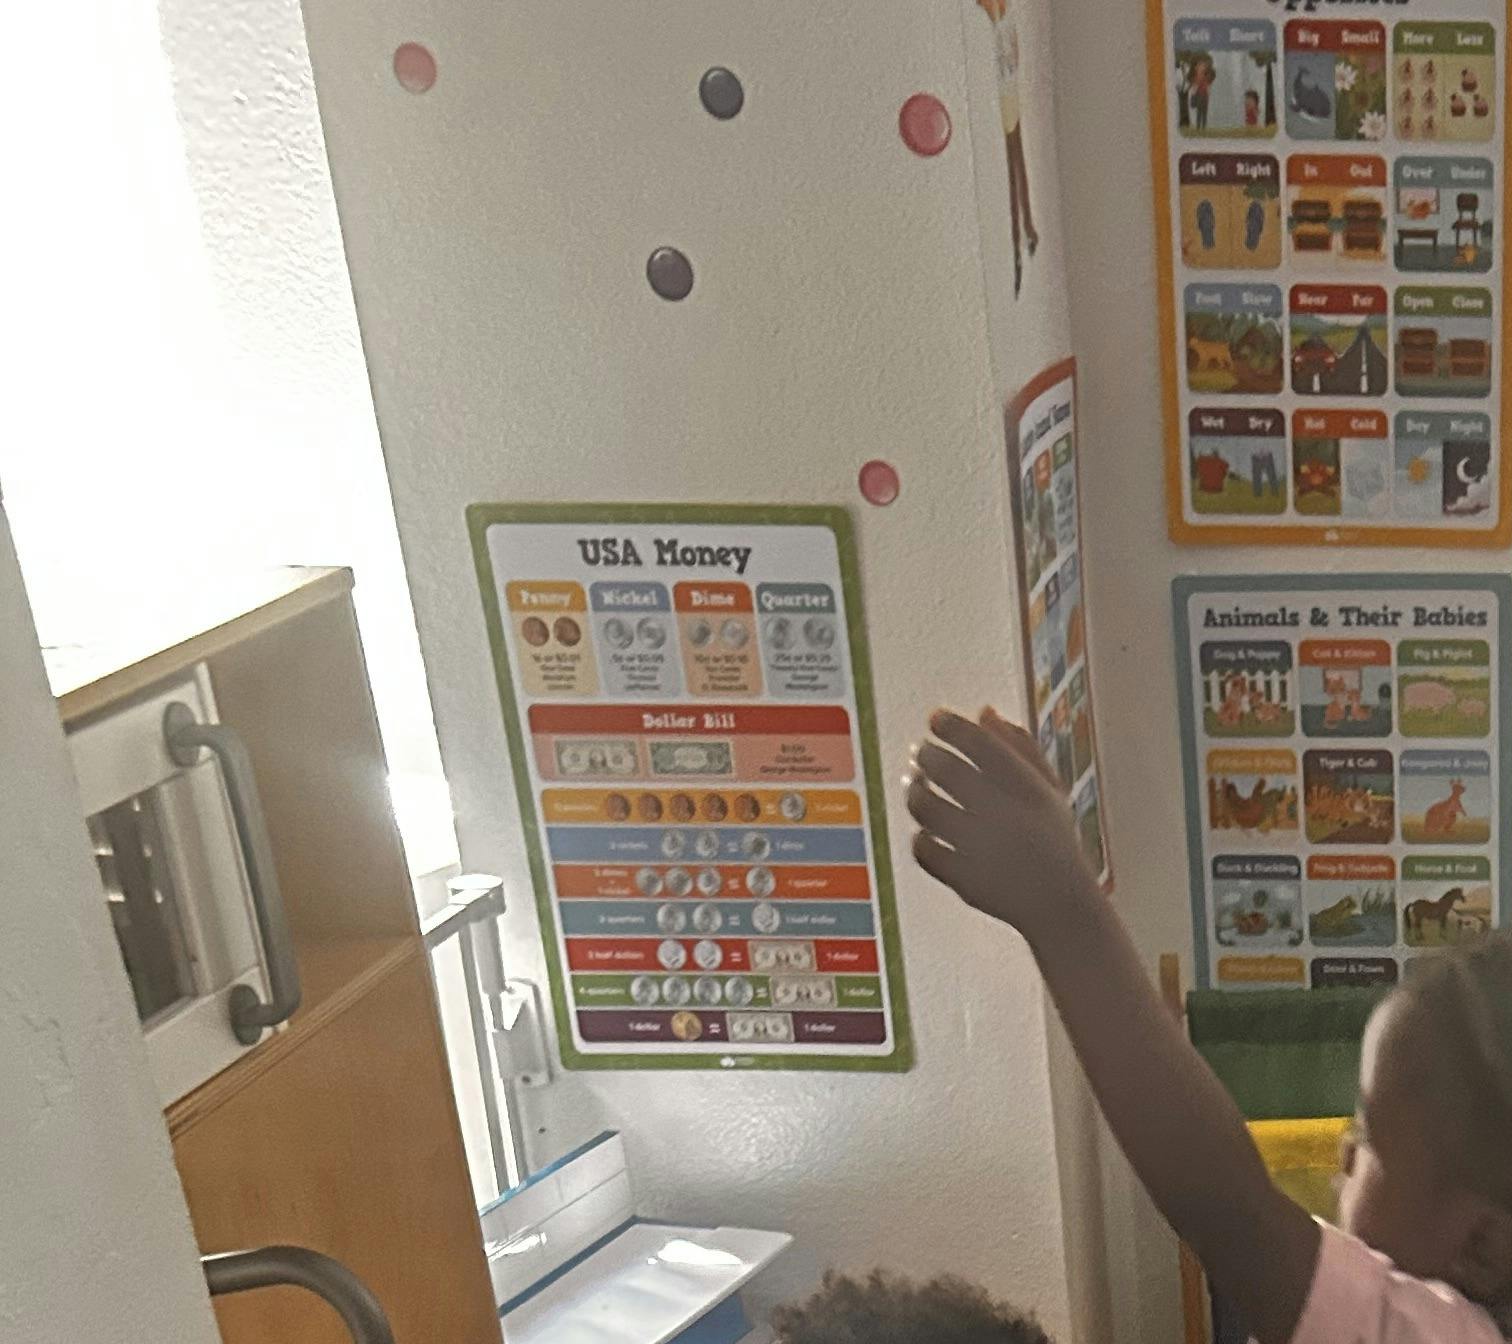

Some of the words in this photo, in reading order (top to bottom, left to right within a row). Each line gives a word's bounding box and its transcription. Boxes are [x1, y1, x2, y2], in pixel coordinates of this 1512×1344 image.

[1297, 29, 1320, 47] Big
[1341, 29, 1380, 46] Small
[1402, 30, 1434, 45] More
[1191, 161, 1217, 176] Left
[1236, 161, 1271, 179] Right
[1401, 164, 1433, 179] Over
[1402, 293, 1434, 311] Open
[1201, 415, 1224, 430] Wet
[1248, 416, 1273, 432] Dry
[1406, 418, 1431, 435] Day
[577, 537, 643, 567] USA
[653, 537, 752, 575] Money
[521, 589, 572, 608] Penny
[602, 590, 658, 606] Nickel
[690, 590, 736, 607] Dime
[761, 591, 830, 609] Quarter
[1203, 606, 1300, 628] Animals
[1310, 606, 1329, 627] &
[1338, 605, 1402, 627] Their
[1412, 605, 1488, 627] Babies
[641, 712, 697, 729] Dollar
[702, 712, 736, 729] Bill
[1319, 757, 1345, 770] Tiger
[1356, 757, 1378, 769] Cub
